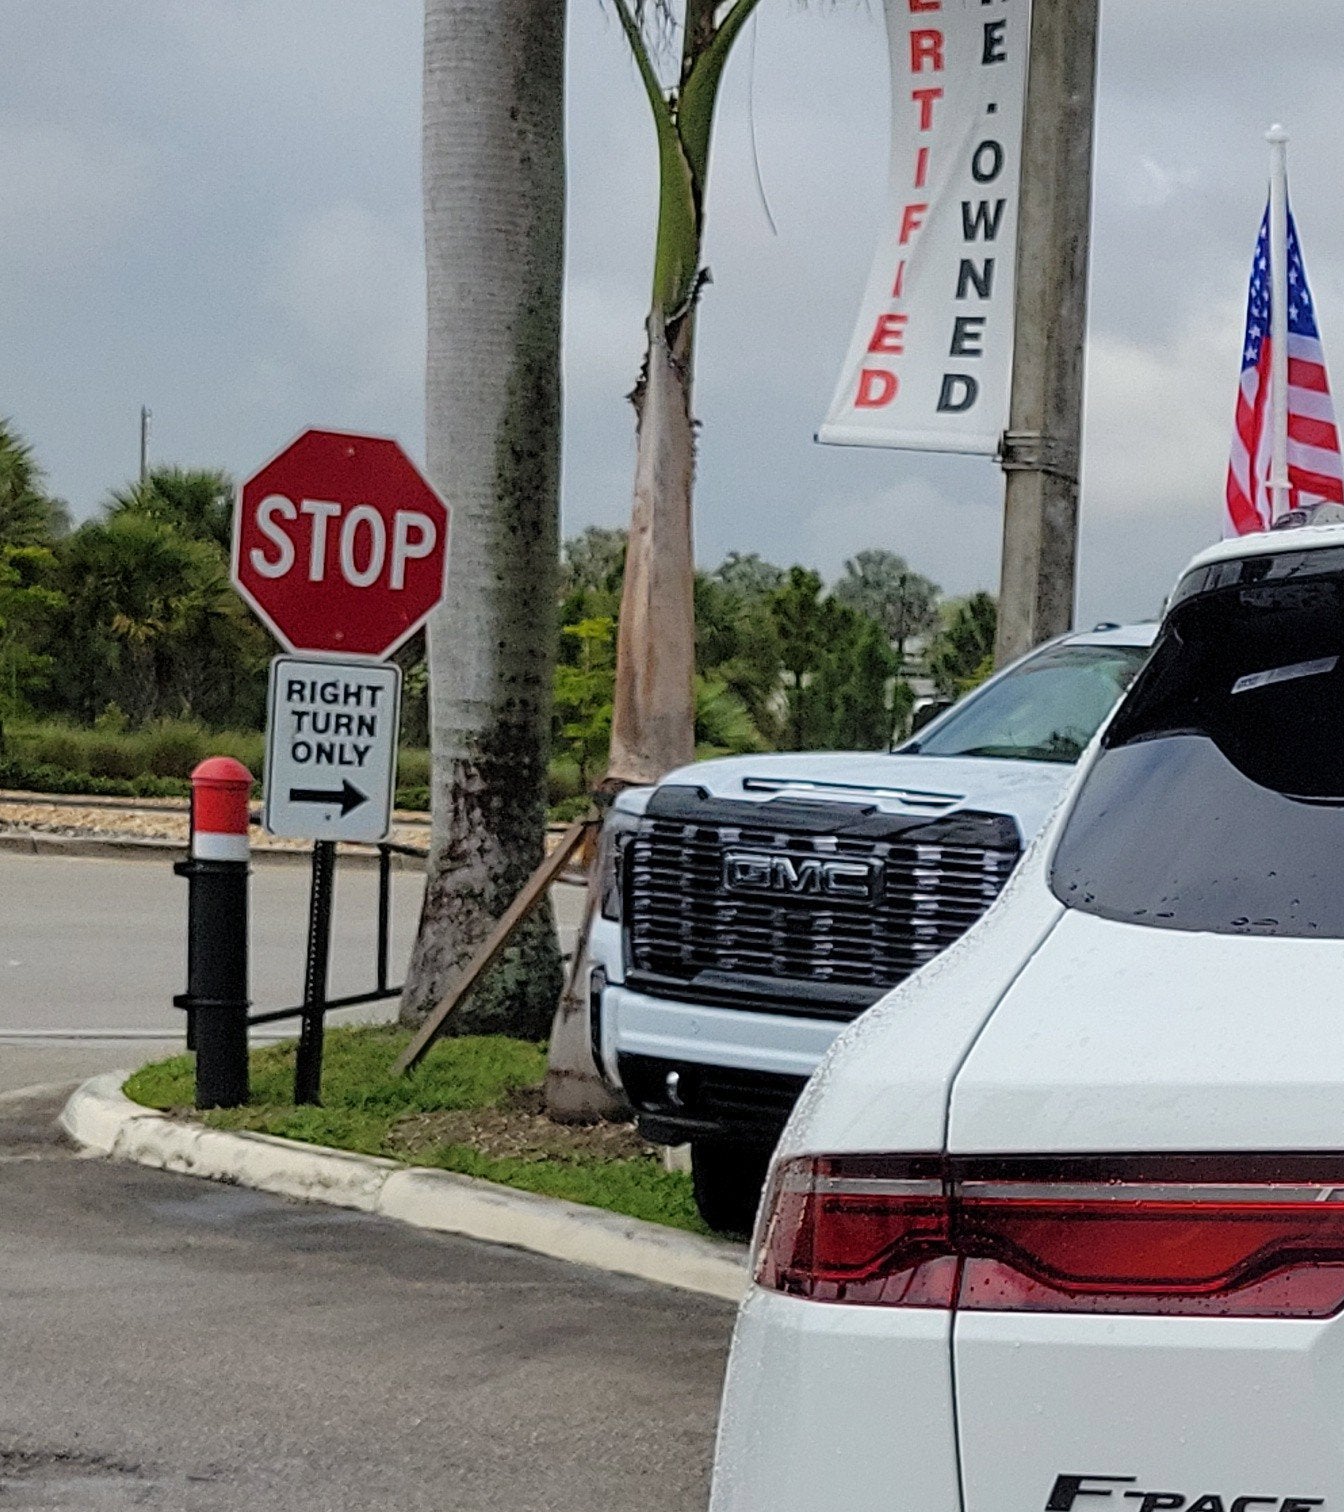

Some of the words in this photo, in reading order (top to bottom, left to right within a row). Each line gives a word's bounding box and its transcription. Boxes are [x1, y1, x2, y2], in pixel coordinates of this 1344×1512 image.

[249, 494, 438, 592] STOP
[286, 679, 385, 708] RIGHT
[291, 709, 377, 738] TURN
[291, 741, 372, 768] ONLY
[728, 855, 870, 897] GMC
